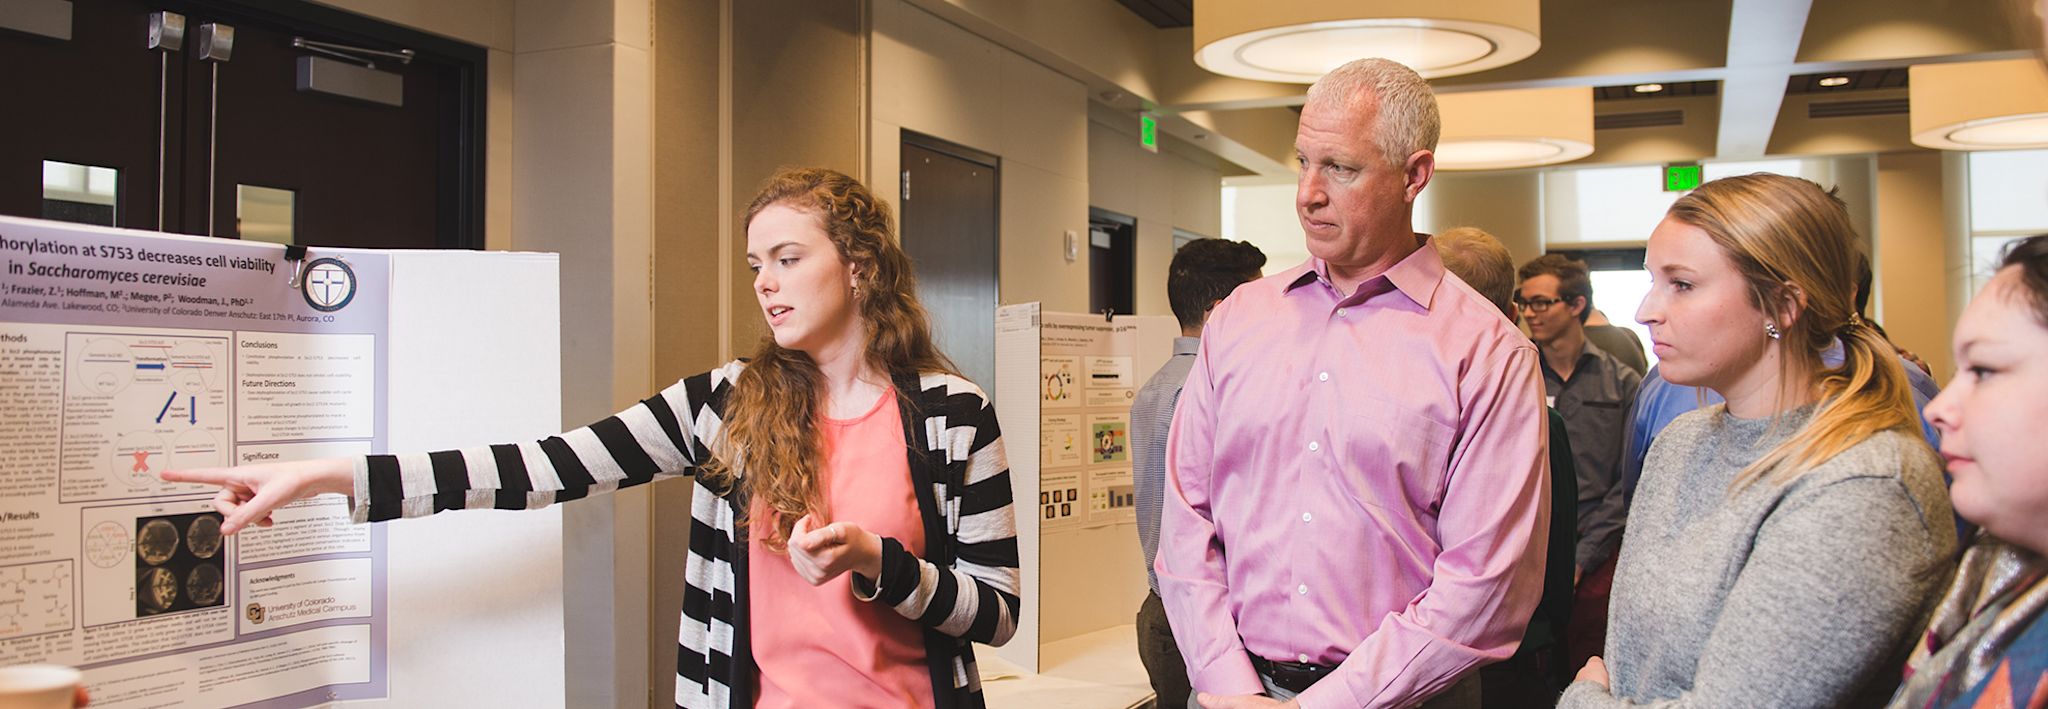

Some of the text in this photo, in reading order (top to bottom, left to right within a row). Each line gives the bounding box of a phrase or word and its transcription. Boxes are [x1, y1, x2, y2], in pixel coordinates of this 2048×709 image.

[82, 245, 97, 257] at
[100, 245, 134, 260] S753
[137, 248, 203, 266] decreases
[206, 254, 227, 268] cell
[229, 256, 276, 275] viability
[8, 260, 207, 288] in Saccharomyces cerevisiae
[11, 285, 47, 297] Frazier,
[66, 288, 108, 300] Hoffman,
[130, 292, 161, 304] Megee,
[178, 295, 220, 307] Woodman,
[1, 299, 40, 309] Alameda
[42, 300, 60, 310] Ave.
[62, 301, 104, 312] Lakewood,
[162, 306, 171, 315] of
[171, 306, 203, 317] Colorado
[204, 309, 227, 318] Denver
[259, 312, 271, 321] East
[273, 313, 286, 321] 17th
[296, 313, 321, 323] Aurora,
[323, 315, 335, 323] CO
[0, 333, 27, 343] thods
[241, 340, 278, 349] Conclusions
[242, 379, 296, 388] Future Directions
[243, 452, 279, 462] Significance
[249, 572, 295, 585] Acknowledgments
[268, 596, 335, 613] University of Colorado
[269, 604, 357, 622] Anschutz Medical Campus
